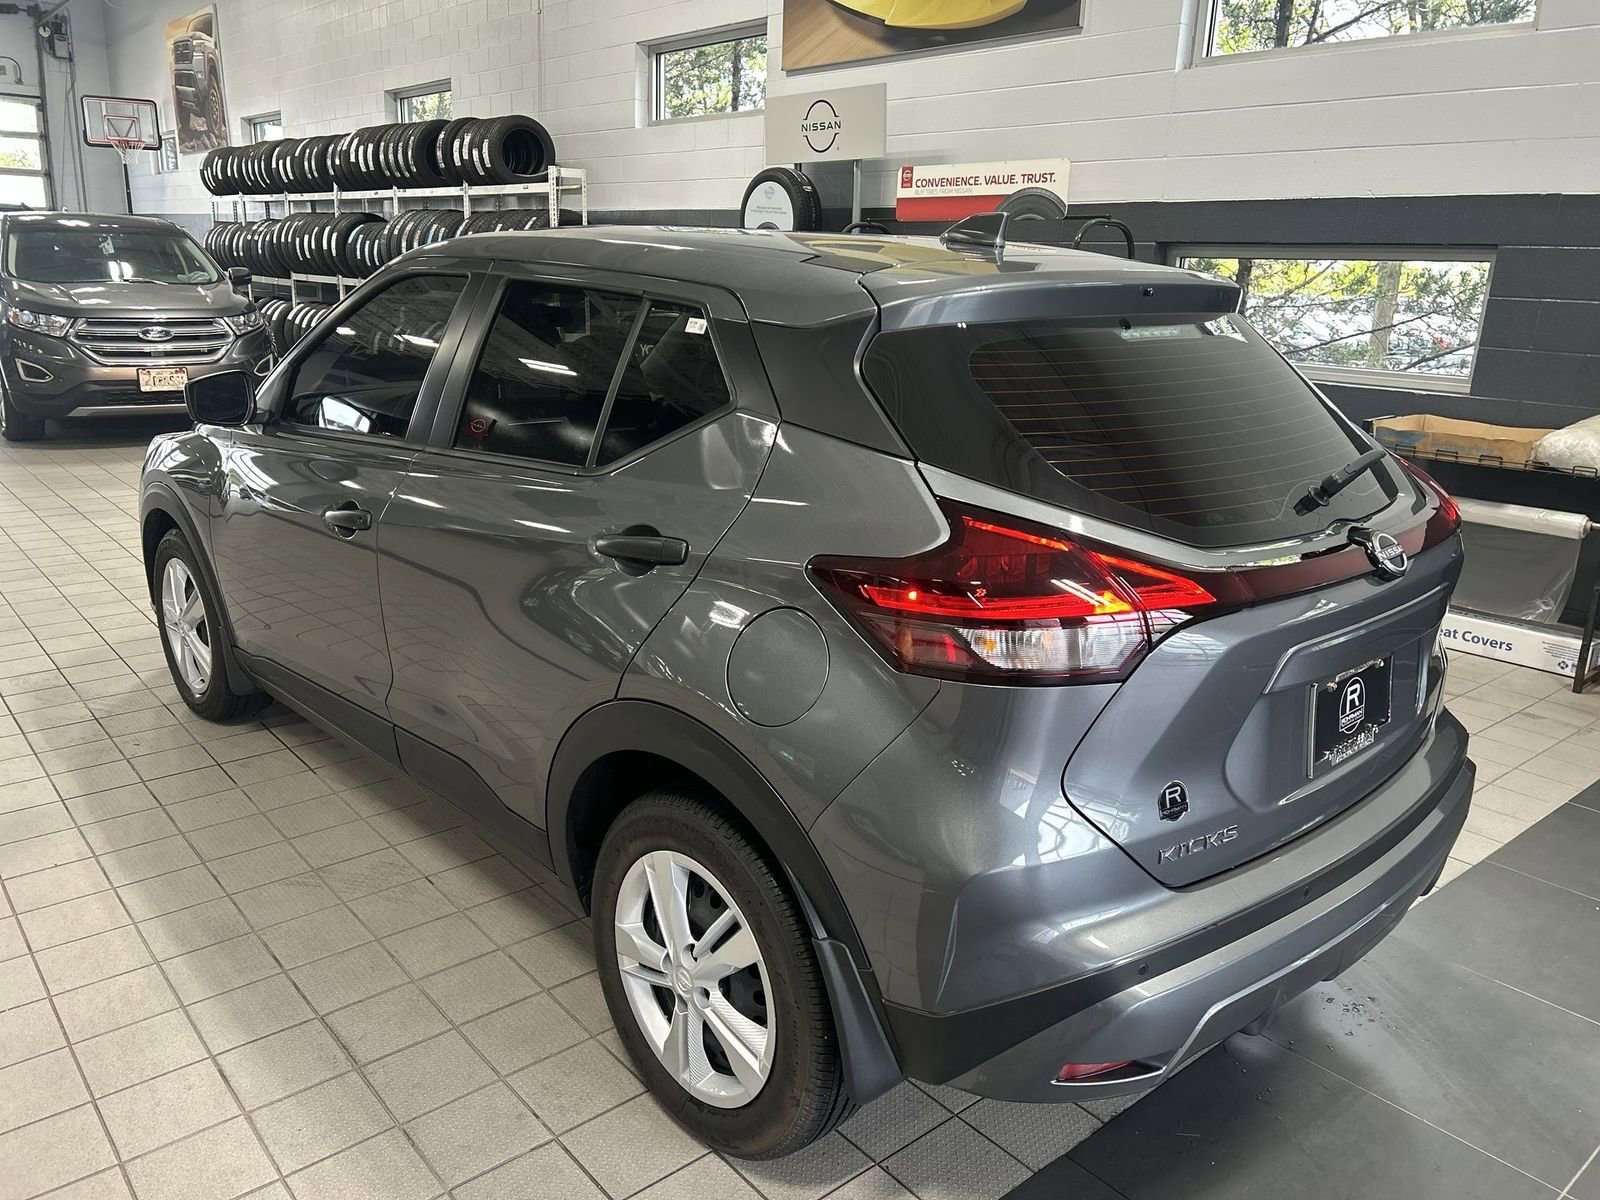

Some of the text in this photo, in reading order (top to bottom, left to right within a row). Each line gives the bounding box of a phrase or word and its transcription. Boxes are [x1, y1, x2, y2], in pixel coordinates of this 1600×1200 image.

[801, 121, 841, 132] NISSAN
[915, 172, 1055, 188] CONVENIENCE. VALUE. TRUST.
[1461, 630, 1513, 652] Covers
[1346, 683, 1361, 714] R
[1165, 786, 1182, 809] R
[1158, 824, 1239, 864] KICKS
